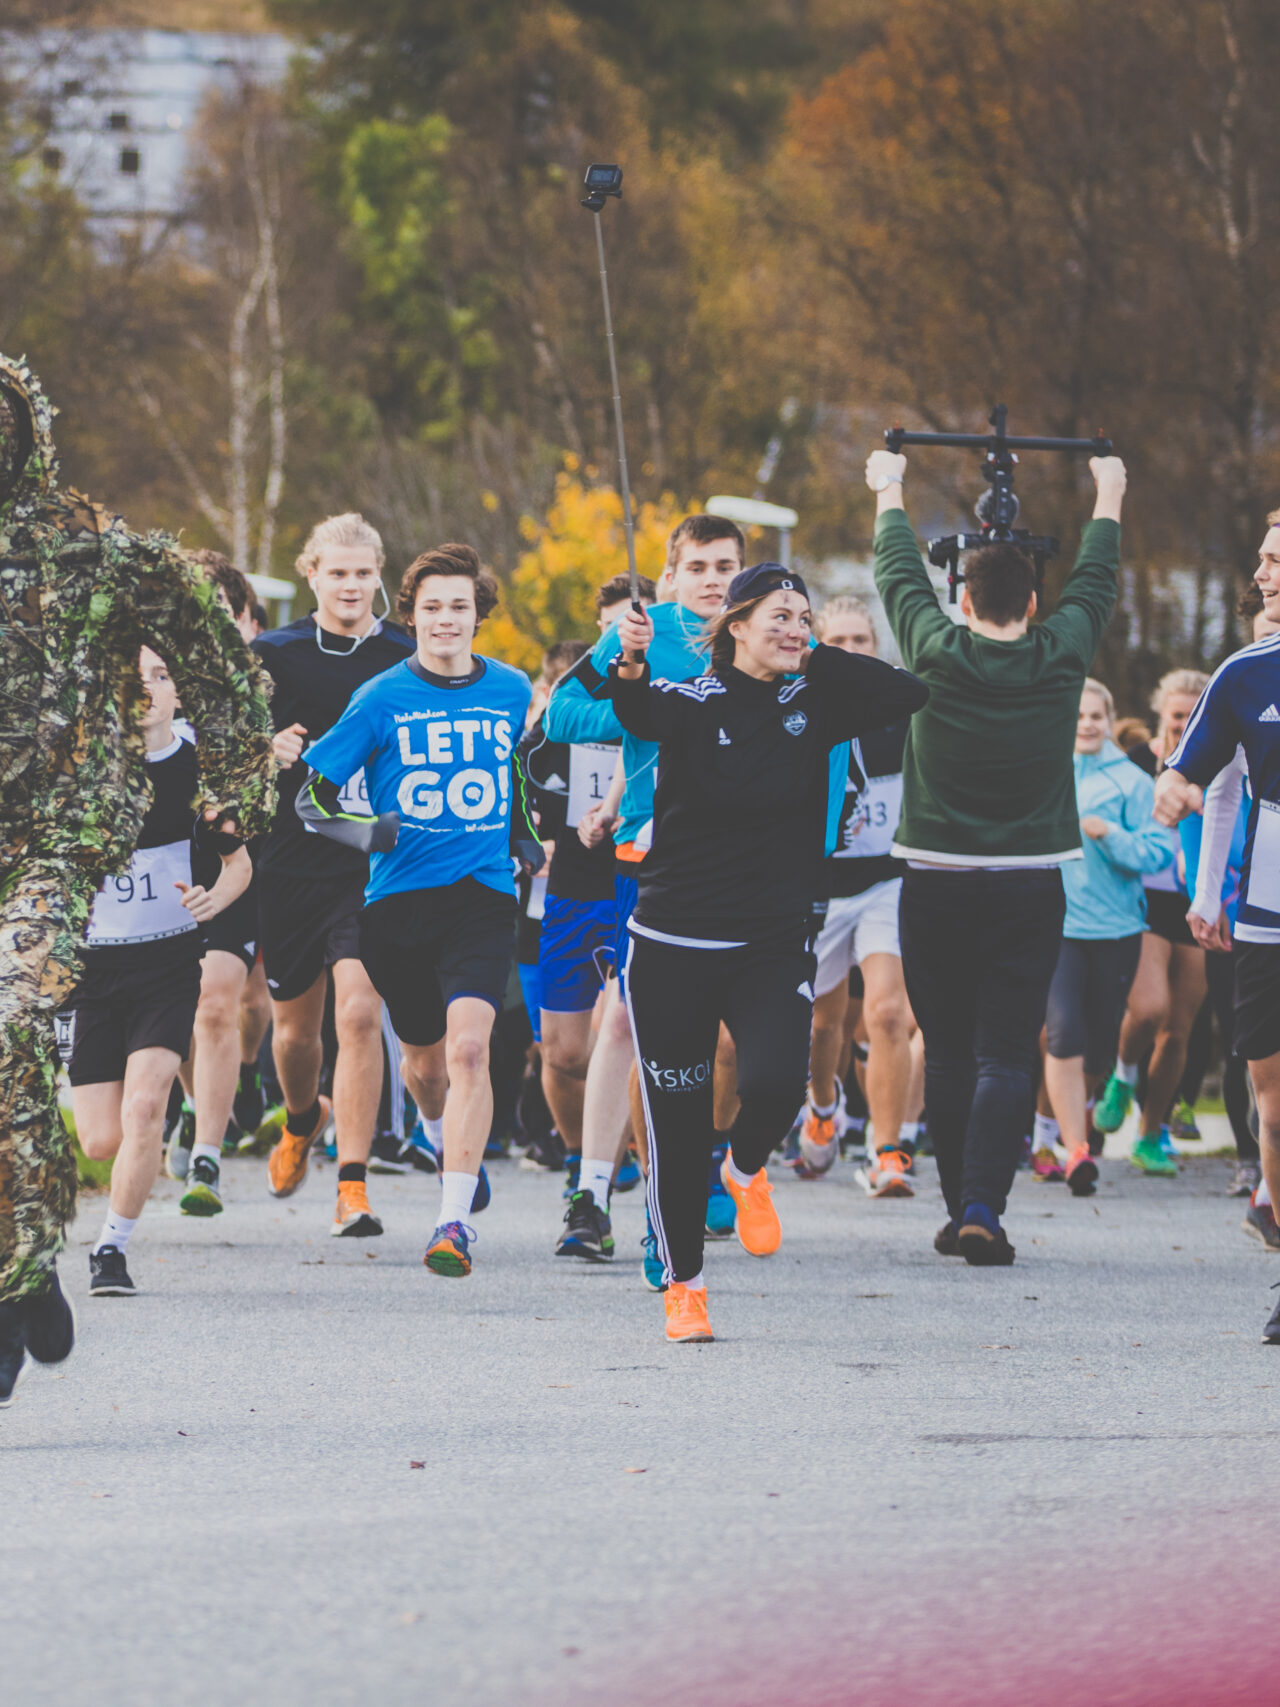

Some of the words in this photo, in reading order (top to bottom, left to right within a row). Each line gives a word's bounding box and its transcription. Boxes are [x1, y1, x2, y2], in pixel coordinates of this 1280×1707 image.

[397, 719, 513, 766] LET'S
[397, 765, 510, 821] GO!
[115, 872, 158, 904] 91
